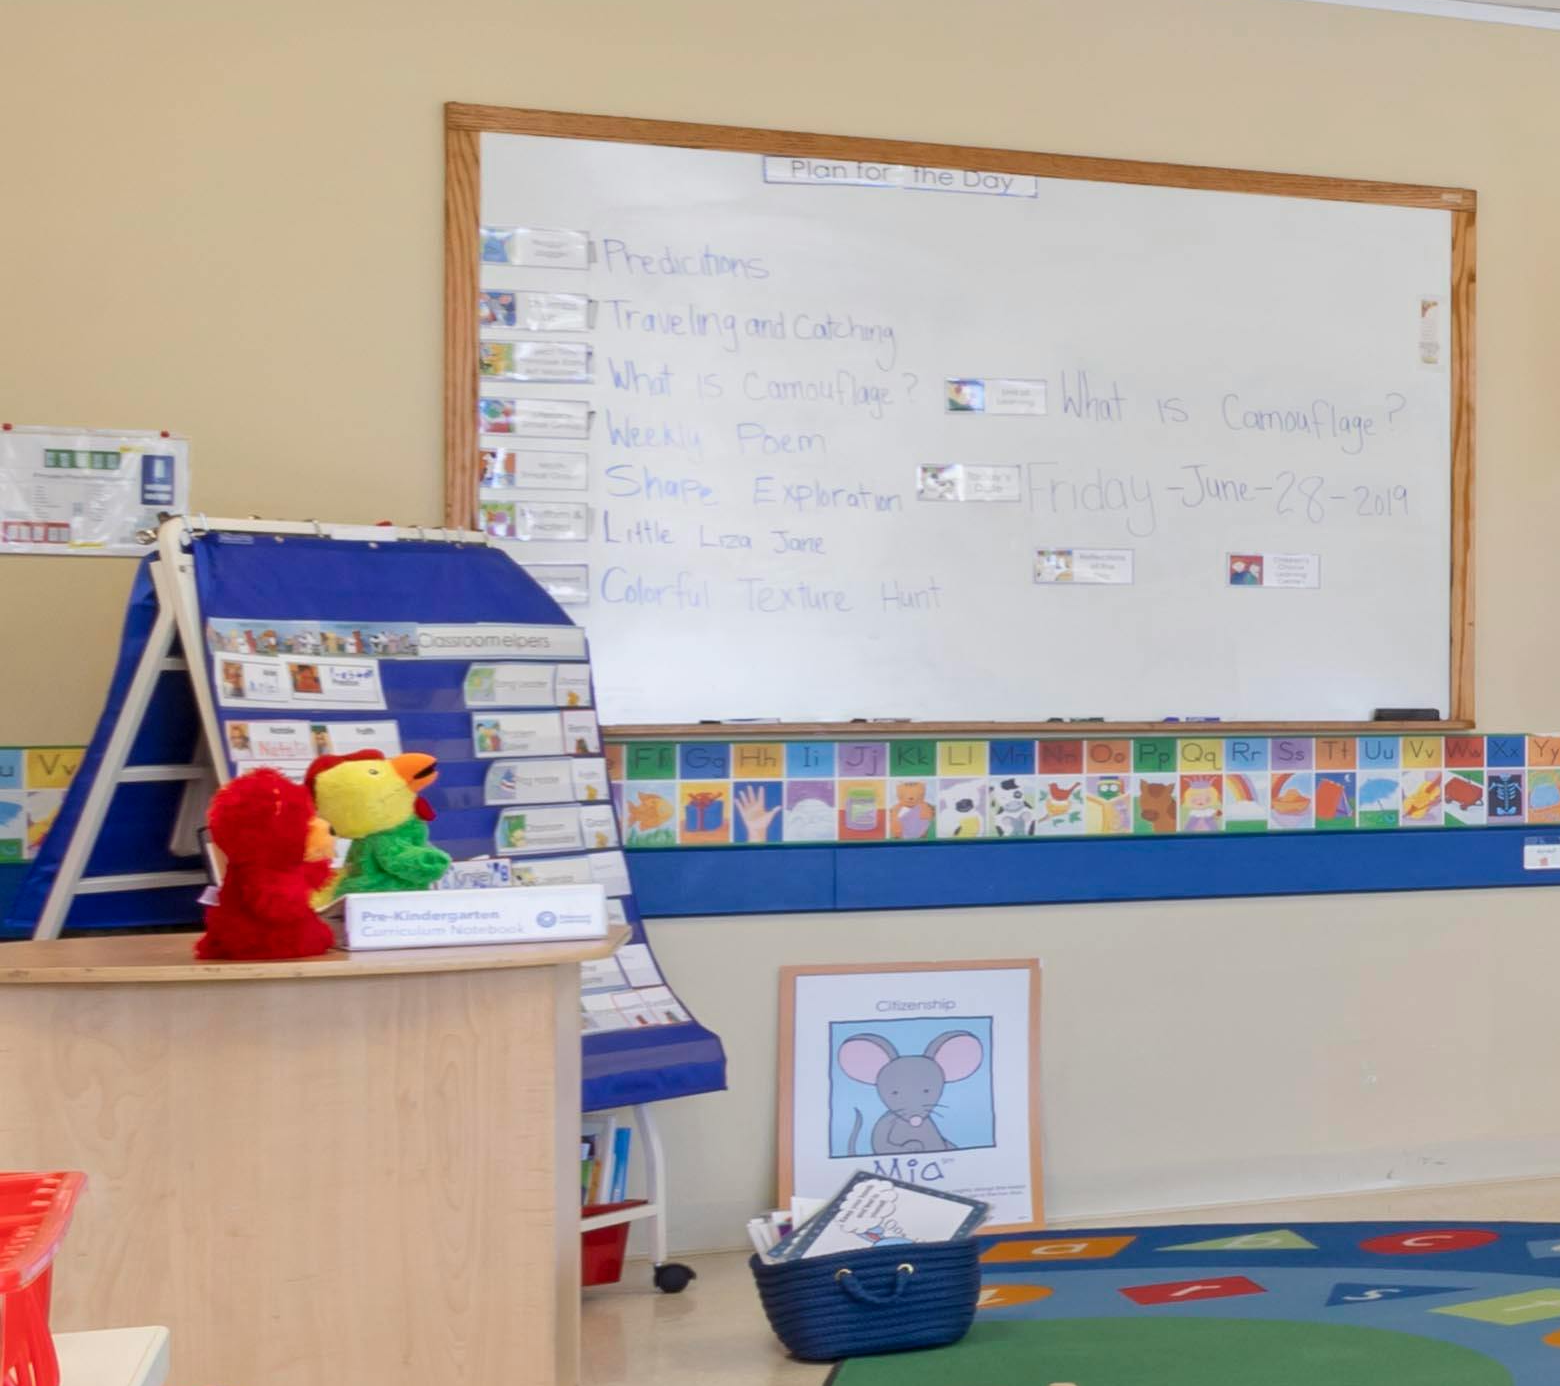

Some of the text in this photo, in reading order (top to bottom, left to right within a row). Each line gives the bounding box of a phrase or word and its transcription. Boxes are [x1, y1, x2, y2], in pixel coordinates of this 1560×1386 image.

[791, 159, 848, 180] Plan
[963, 170, 1014, 193] Day
[604, 299, 738, 353] Traveling
[745, 312, 785, 341] and
[793, 314, 895, 371] Catching
[608, 357, 674, 395] What
[1060, 370, 1127, 423] What
[736, 422, 828, 455] Poem
[605, 464, 719, 506] Shape
[753, 476, 903, 512] Exploration
[770, 530, 827, 555] Jane
[601, 566, 711, 609] Colorful
[737, 577, 853, 613] Texture
[880, 577, 945, 612] Hunt
[633, 747, 670, 770] Ff
[684, 747, 726, 779] Gg
[739, 747, 778, 769] Hh
[802, 747, 820, 768] Ii
[845, 745, 879, 777] Jj
[899, 745, 930, 767] Kk
[948, 744, 973, 767] Ll
[1090, 744, 1126, 765] Oo
[1139, 744, 1171, 772] Pp
[1181, 743, 1222, 771] Qq
[1231, 741, 1262, 762] Rr
[1278, 741, 1305, 762] Ss
[1325, 741, 1348, 762] Tt
[1364, 741, 1394, 761] Uu
[1409, 740, 1435, 760] Vv
[1445, 740, 1482, 760] Ww
[1491, 739, 1519, 759] Xx
[1534, 738, 1560, 764] Yy
[361, 909, 501, 926] Pre-Kindergarten
[361, 923, 526, 938] Curriculum Notebook
[875, 997, 957, 1013] Citizenship
[873, 1158, 945, 1183] Mia
